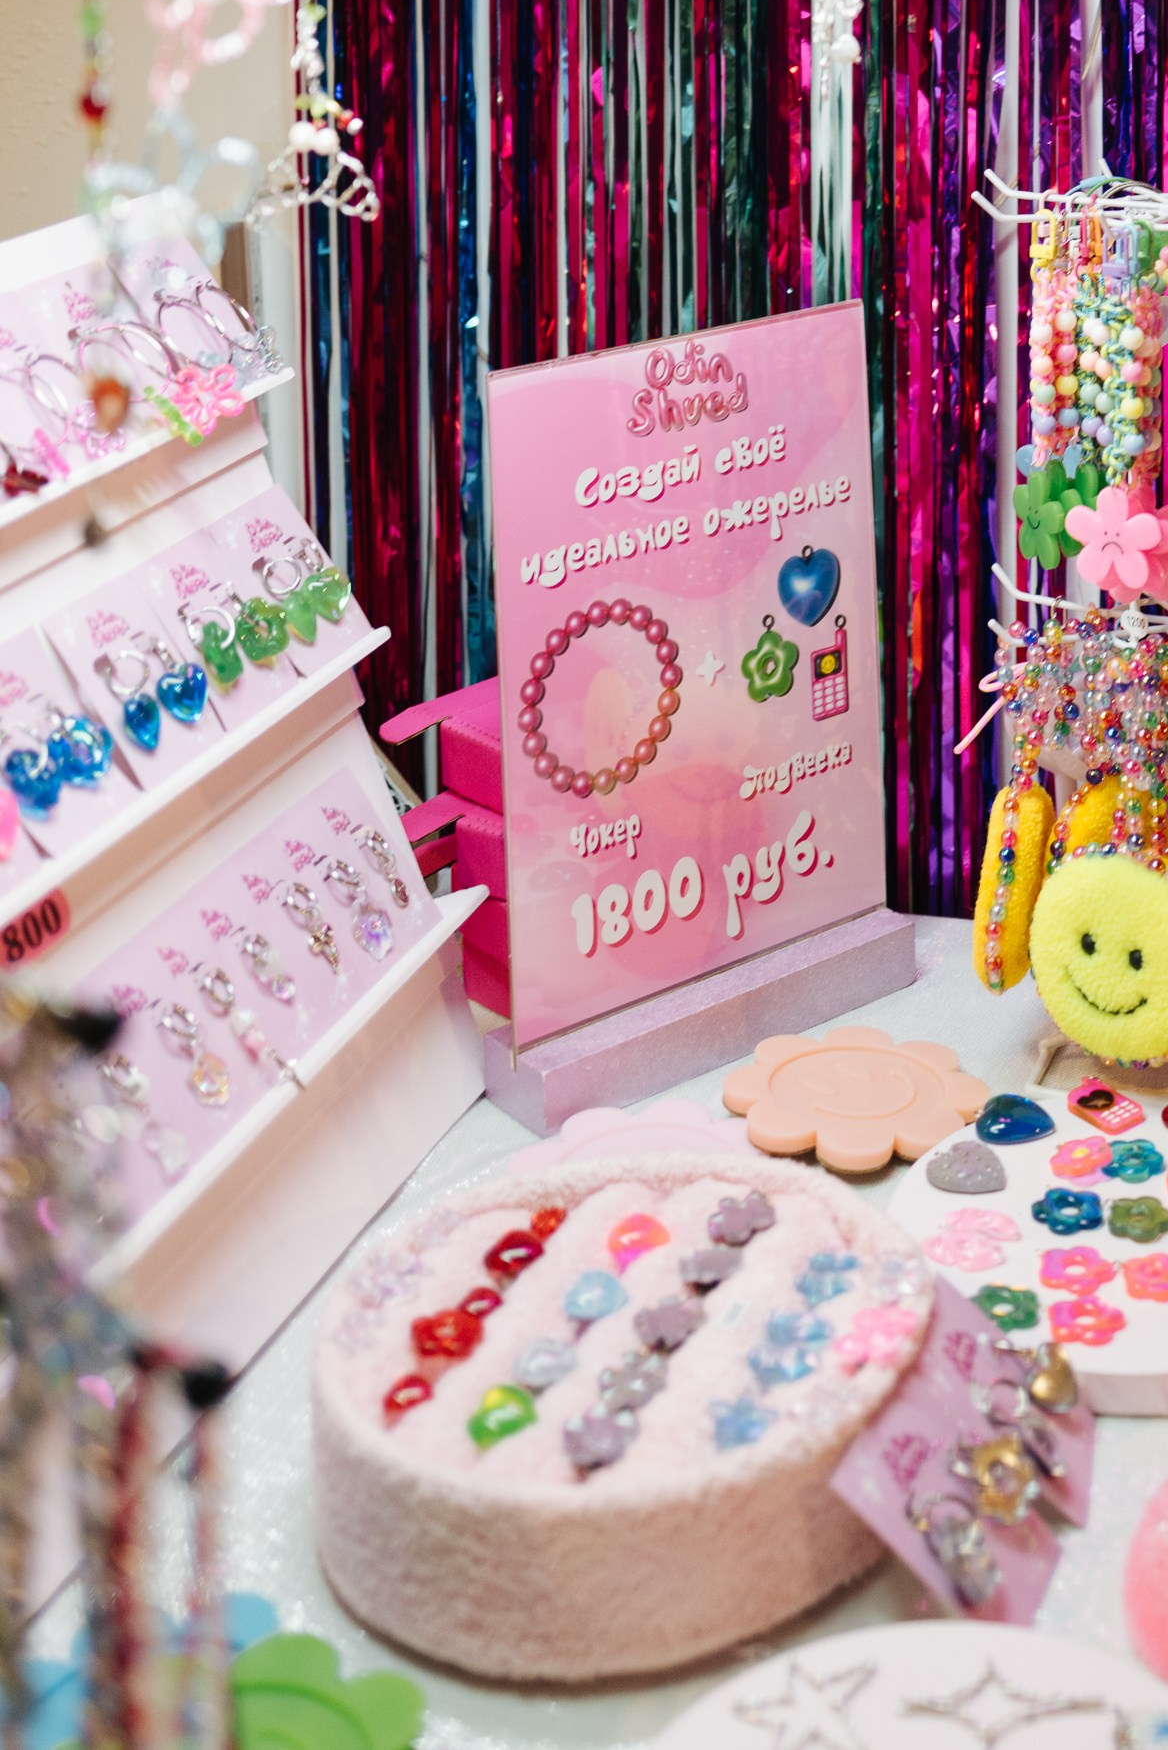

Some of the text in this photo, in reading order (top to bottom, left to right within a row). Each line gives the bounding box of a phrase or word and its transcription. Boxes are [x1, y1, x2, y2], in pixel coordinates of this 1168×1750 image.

[645, 339, 734, 389] Odin
[574, 423, 786, 508] Создай своё
[520, 475, 851, 589] идеальное ожерелье
[571, 810, 834, 957] 1800 руб.
[2, 898, 62, 963] 800
